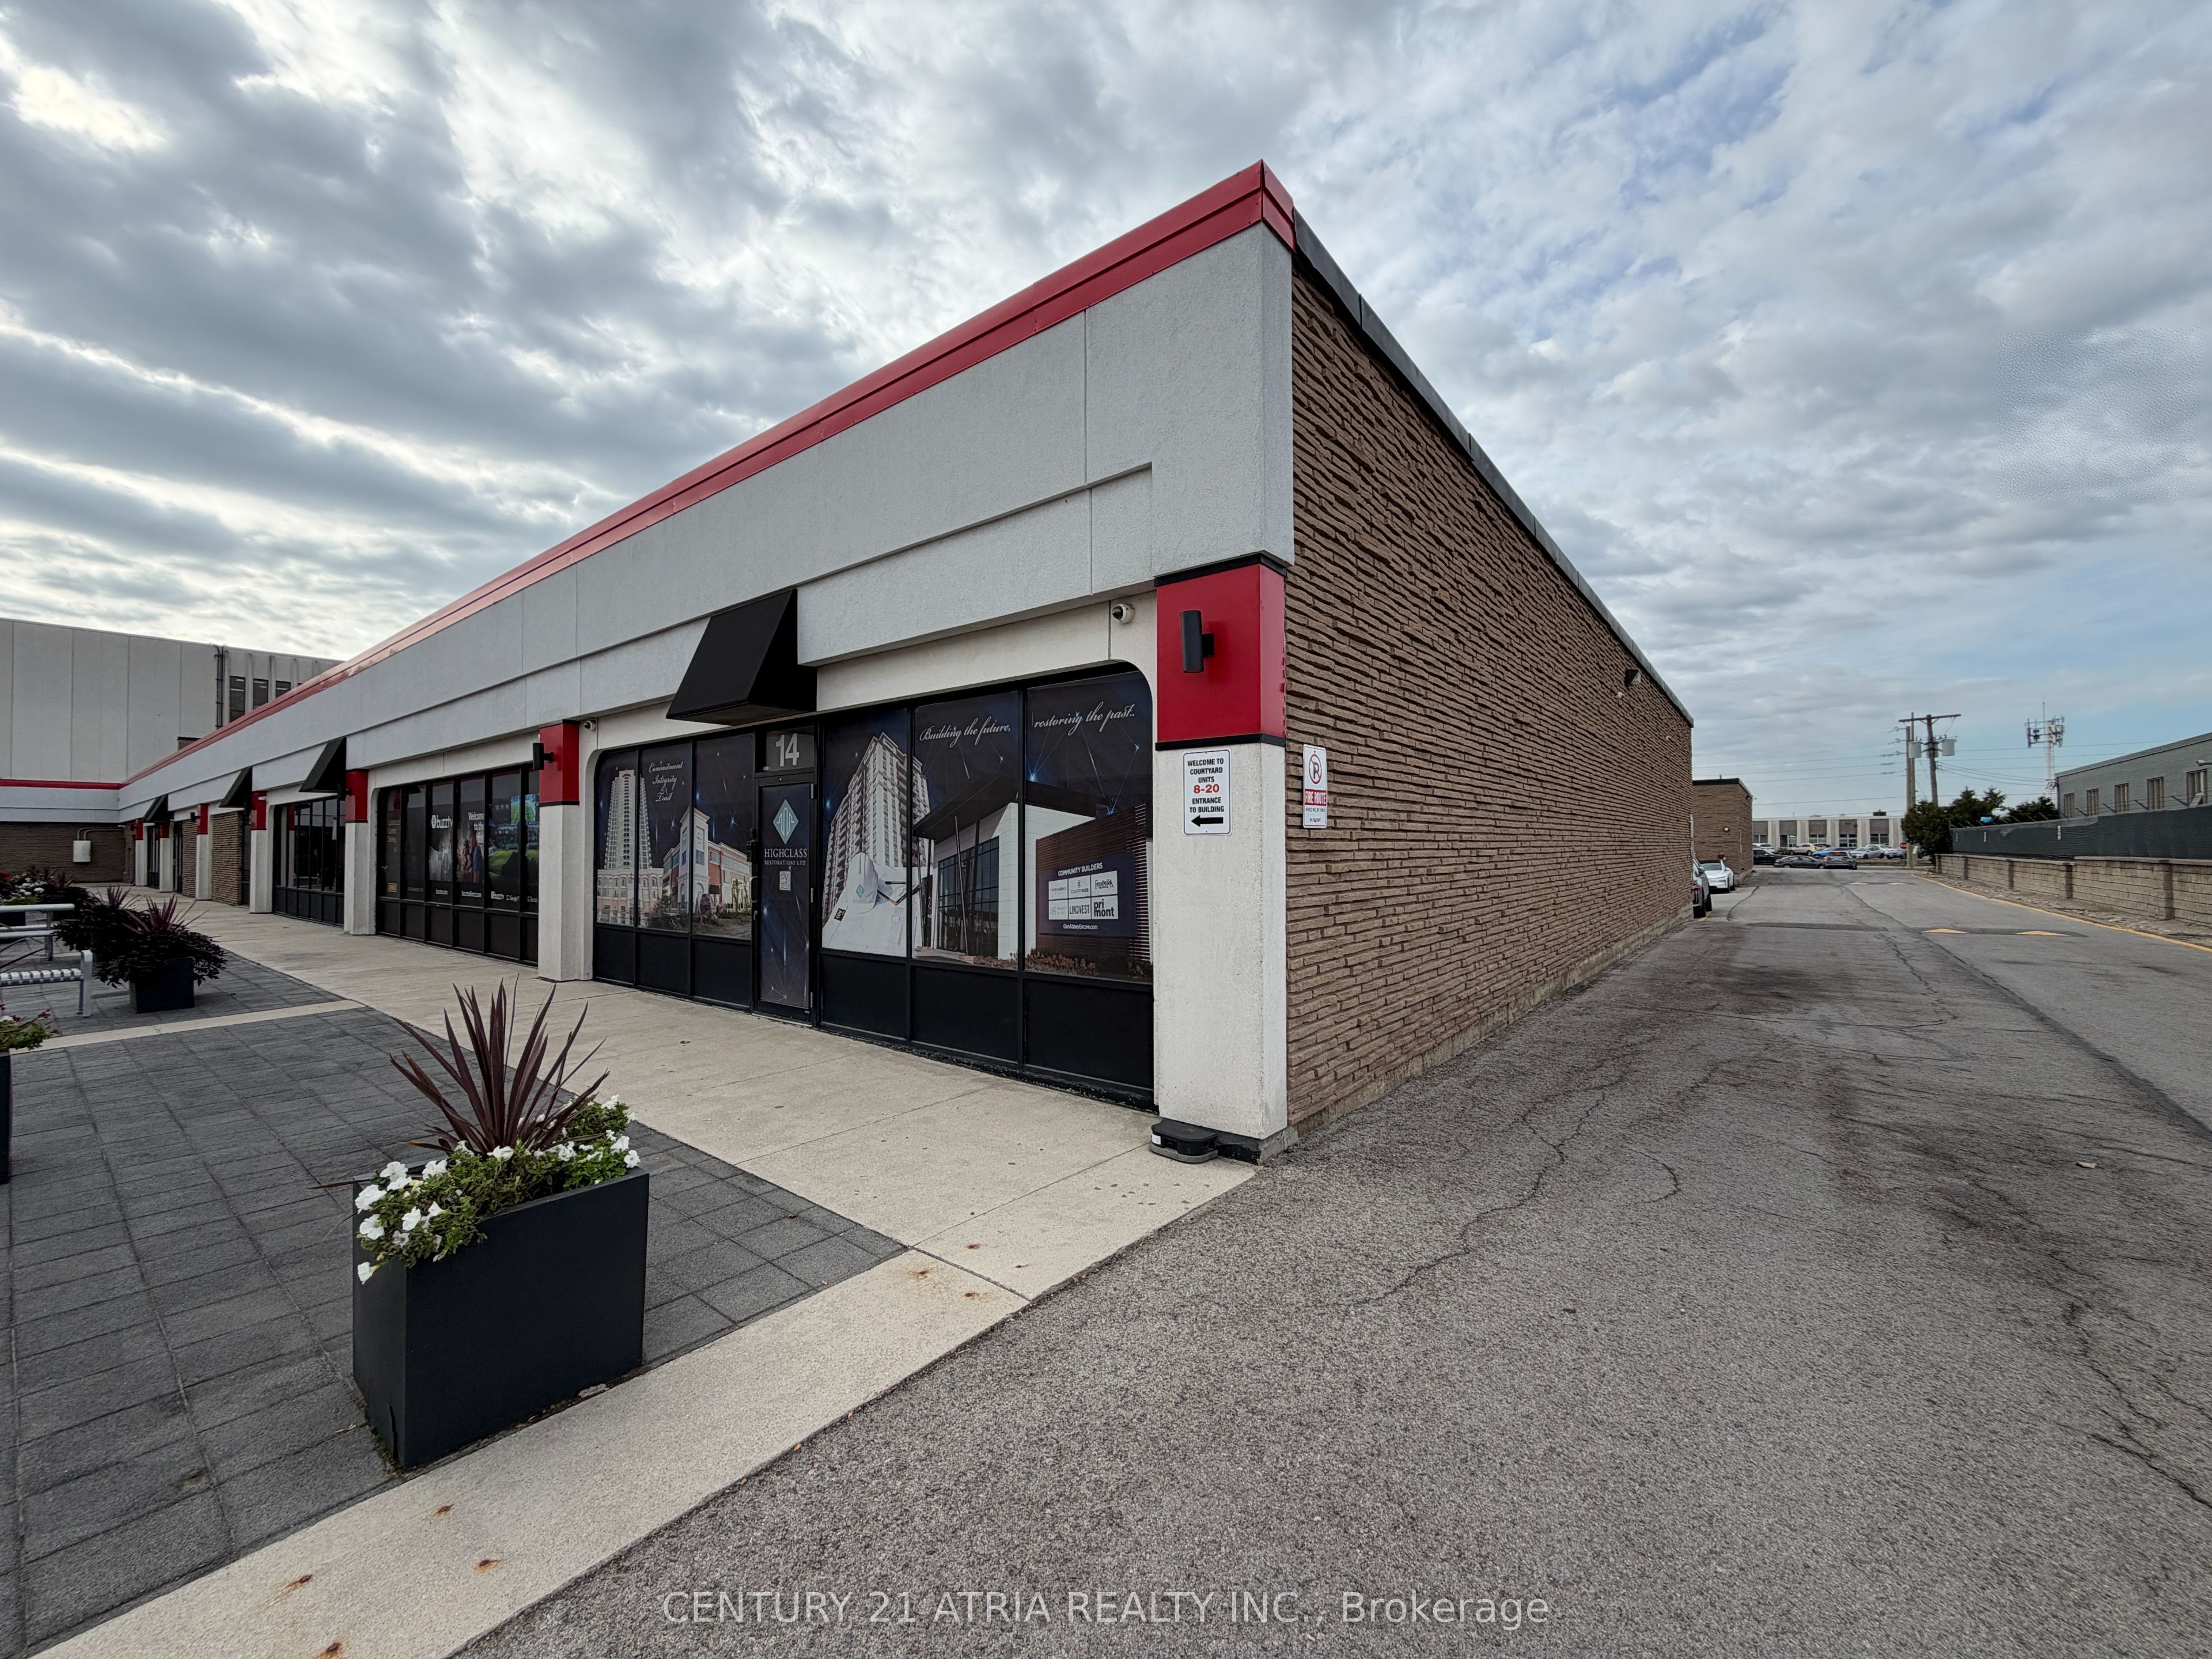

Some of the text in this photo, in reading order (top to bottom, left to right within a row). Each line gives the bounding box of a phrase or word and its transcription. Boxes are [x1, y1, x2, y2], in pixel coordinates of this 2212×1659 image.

[1034, 713, 1083, 736] restoring
[1085, 701, 1104, 722] the
[919, 716, 1011, 748] Building the future,
[776, 733, 800, 767] 14
[649, 761, 684, 773] Commitment
[1187, 759, 1215, 767] WELCOME
[1190, 767, 1223, 775] COURTYARD
[652, 774, 677, 790] Integrity
[1193, 783, 1220, 794] 8-20
[655, 792, 673, 802] Trust
[1192, 797, 1222, 805] ENTRANCE
[1305, 790, 1314, 804] FIRE
[764, 848, 808, 858] HIGHCLASS
[1058, 863, 1103, 876] COMMUNITY BUILDERS
[1094, 899, 1104, 910] pri
[1094, 907, 1114, 916] mont
